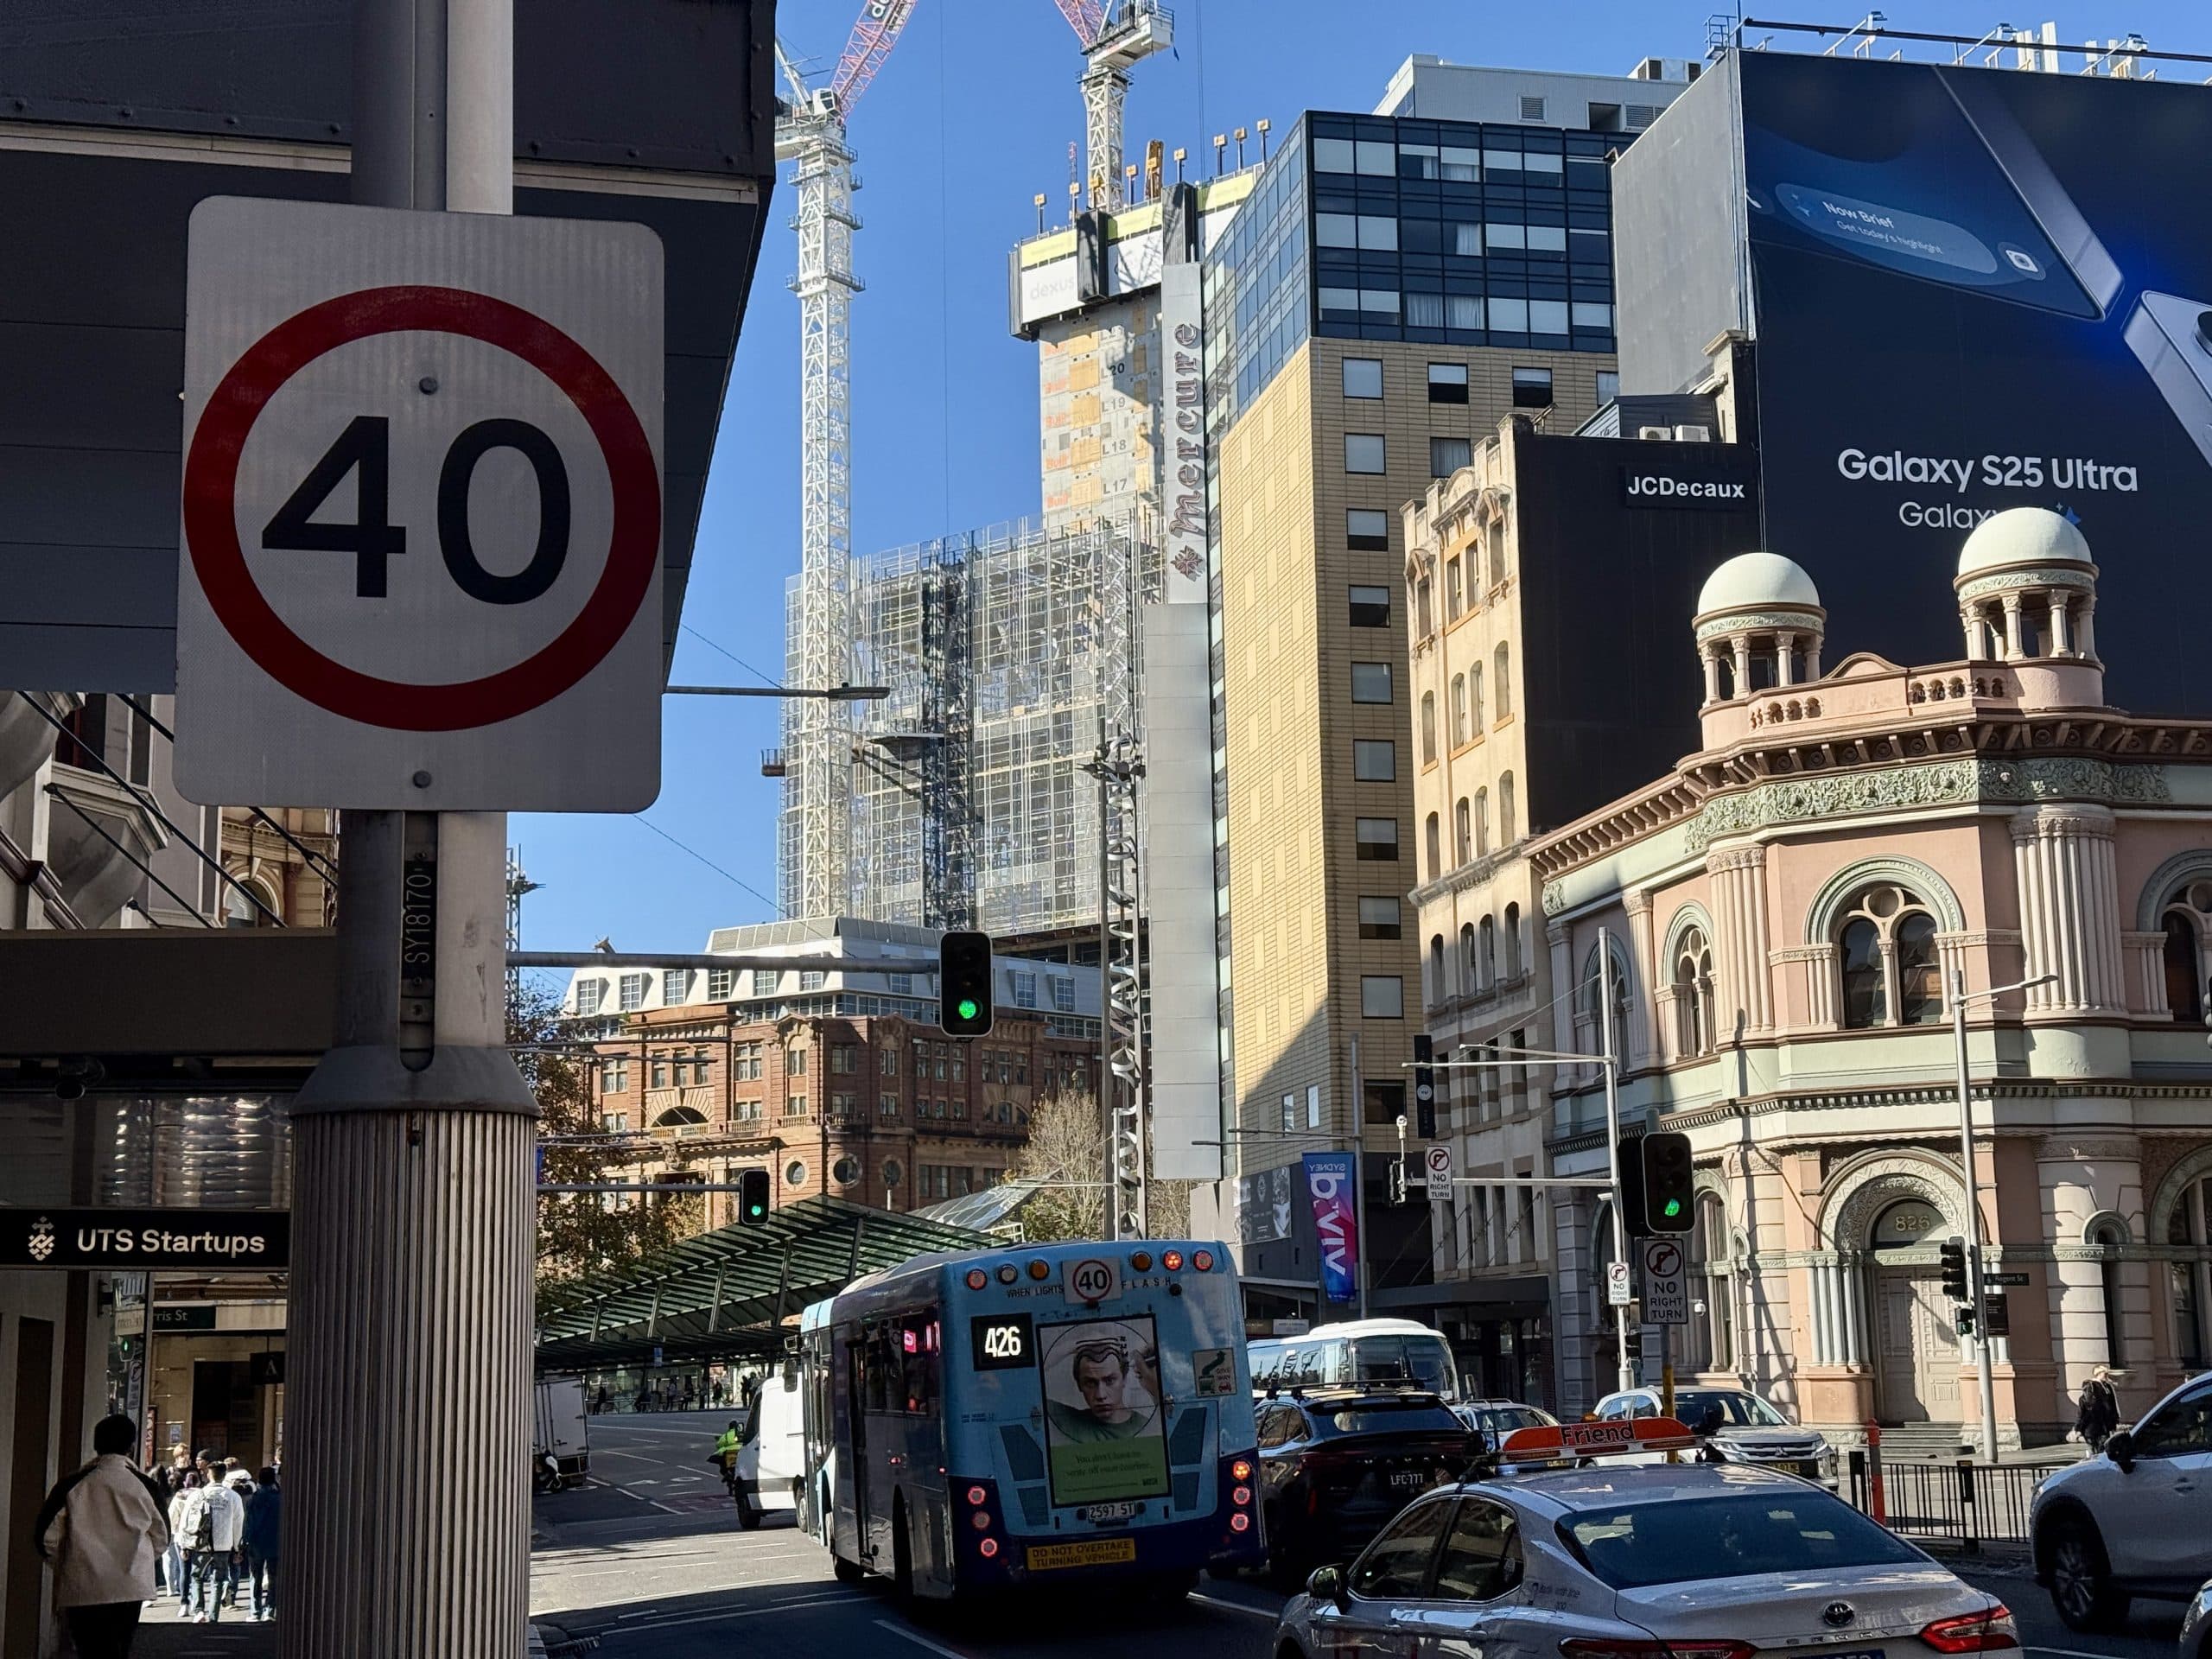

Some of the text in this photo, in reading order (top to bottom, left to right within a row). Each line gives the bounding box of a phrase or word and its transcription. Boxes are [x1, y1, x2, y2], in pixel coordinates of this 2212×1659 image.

[1822, 200, 1895, 229] Now Brief
[1101, 397, 1126, 413] L19
[1102, 439, 1127, 455] L18
[1837, 448, 2139, 493] Galaxy S25 Ultra
[1103, 478, 1128, 494] L17
[1627, 476, 1745, 499] JCDecaux
[261, 416, 571, 605] 40
[1898, 501, 1999, 530] Galax
[1433, 1173, 1446, 1182] NO
[77, 1228, 266, 1259] UTS Startups
[1077, 1268, 1109, 1291] 40
[1121, 1276, 1172, 1290] FLASH
[1654, 1281, 1676, 1294] NO
[1006, 1284, 1065, 1298] WHEN LIGHTS
[1649, 1297, 1682, 1307] RIGHT
[154, 1310, 172, 1321] ris
[1651, 1310, 1681, 1319] TURN
[984, 1326, 1022, 1357] 426
[265, 1360, 277, 1376] A
[1560, 1421, 1635, 1446] Friend
[1090, 1503, 1134, 1518] 2597 ST
[1032, 1540, 1131, 1558] DO NOT OVERTAKE
[1035, 1554, 1082, 1567] TURNING
